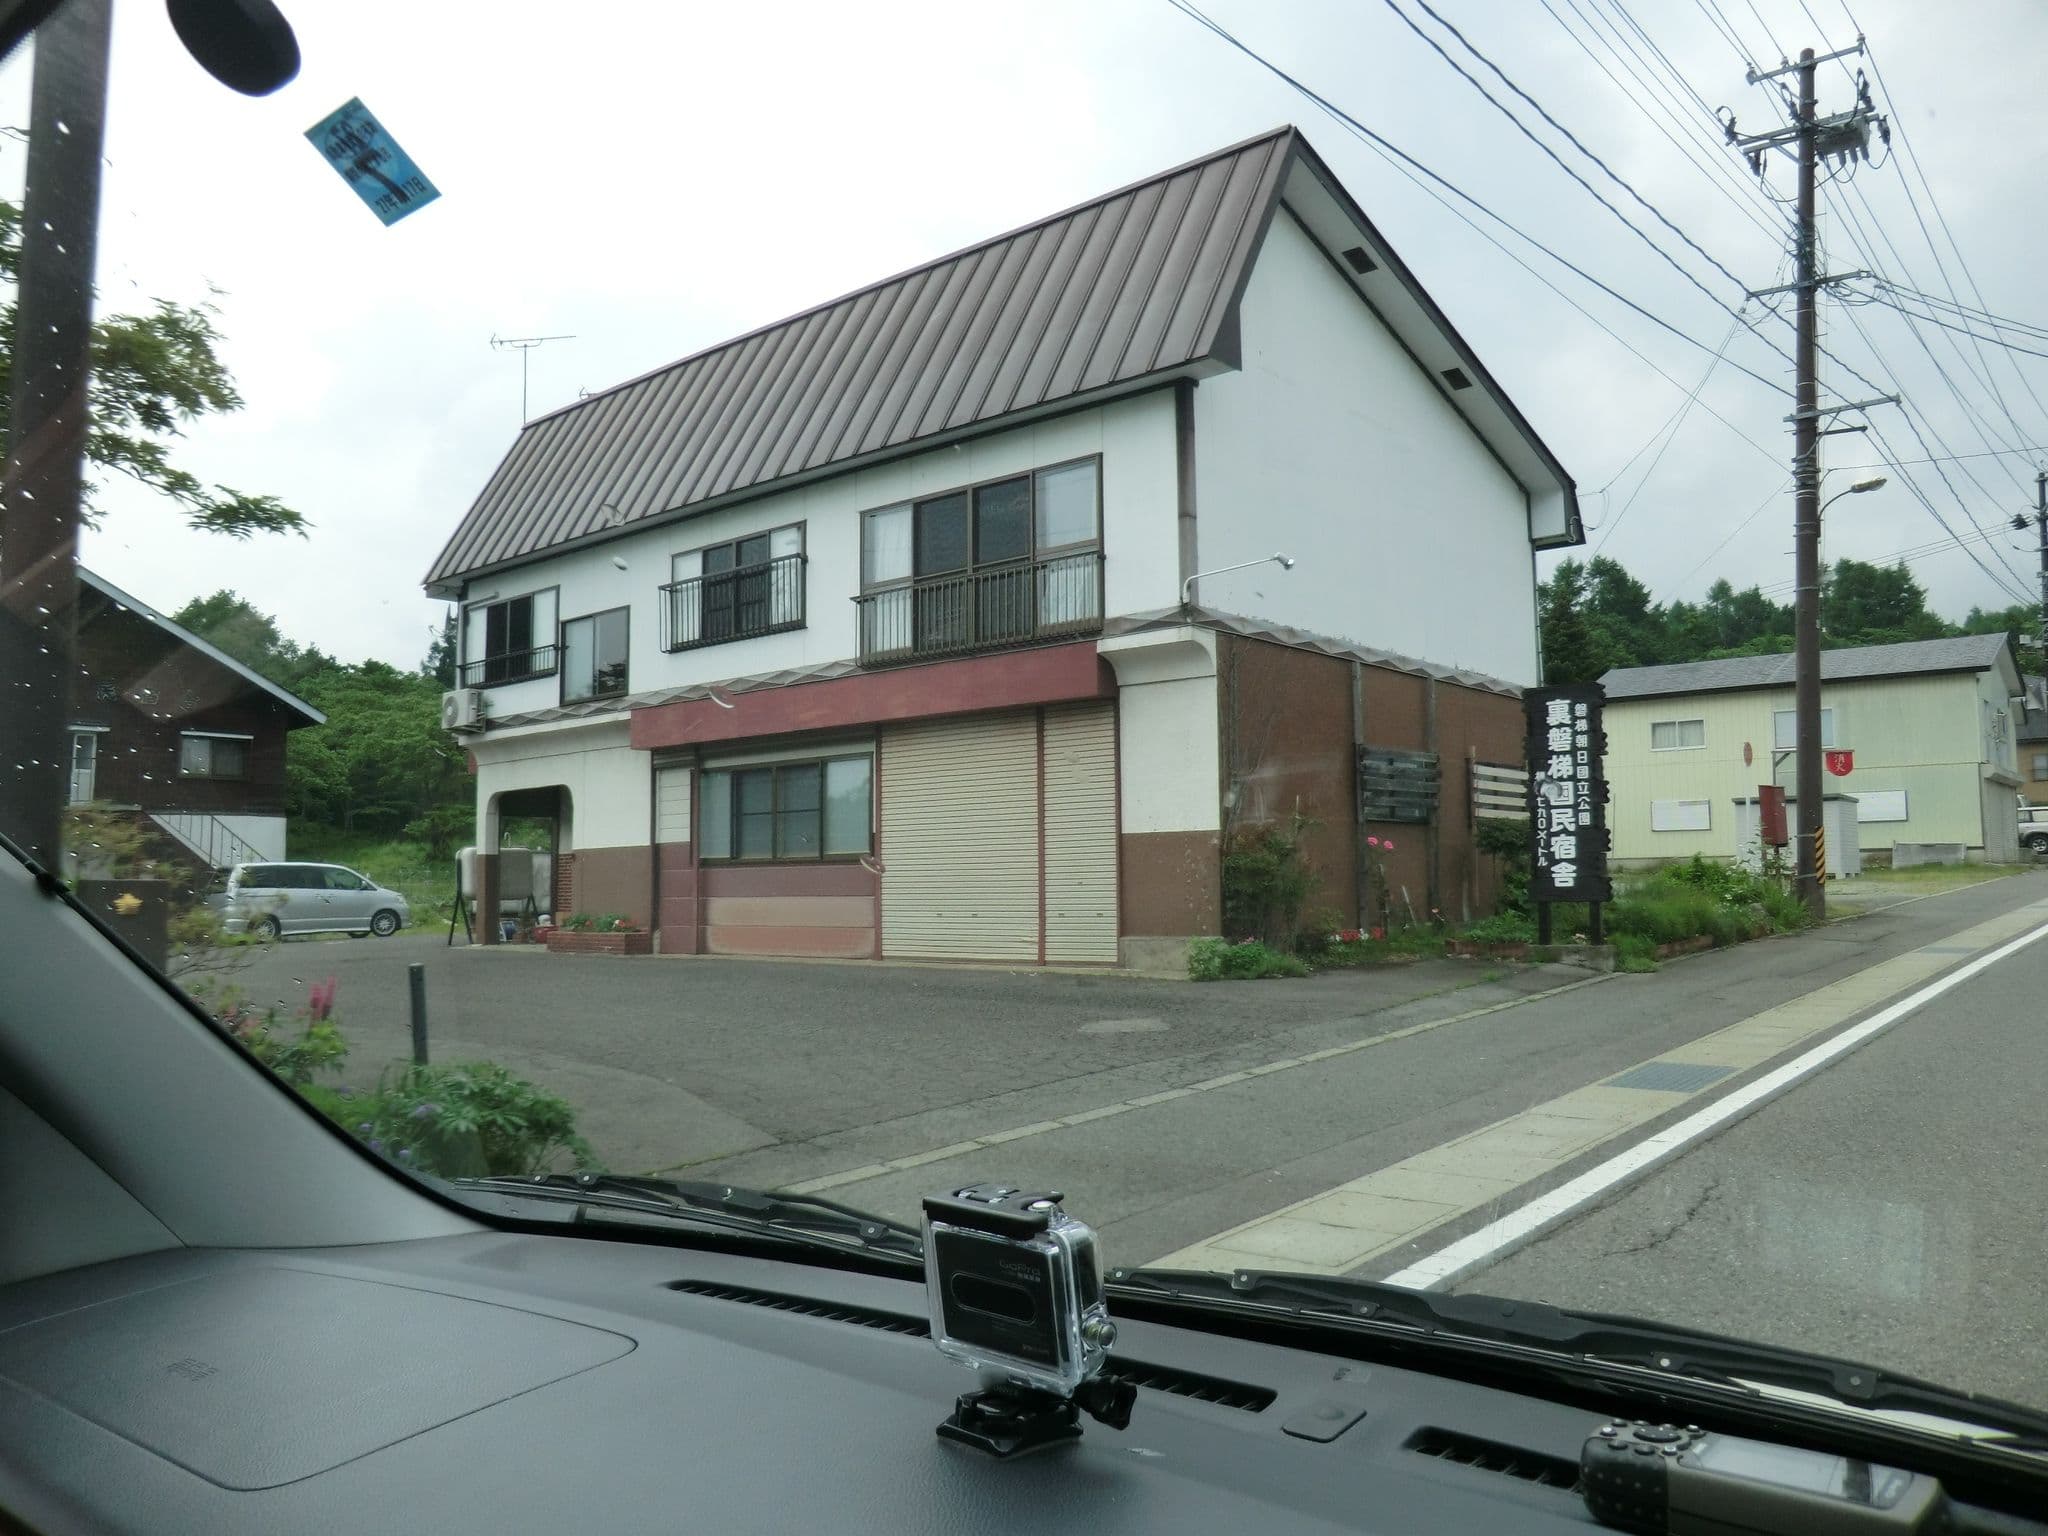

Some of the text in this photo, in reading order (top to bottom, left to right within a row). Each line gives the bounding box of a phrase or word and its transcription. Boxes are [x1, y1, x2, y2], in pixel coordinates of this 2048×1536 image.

[1575, 703, 1591, 826] 磐梯朝日国立公園
